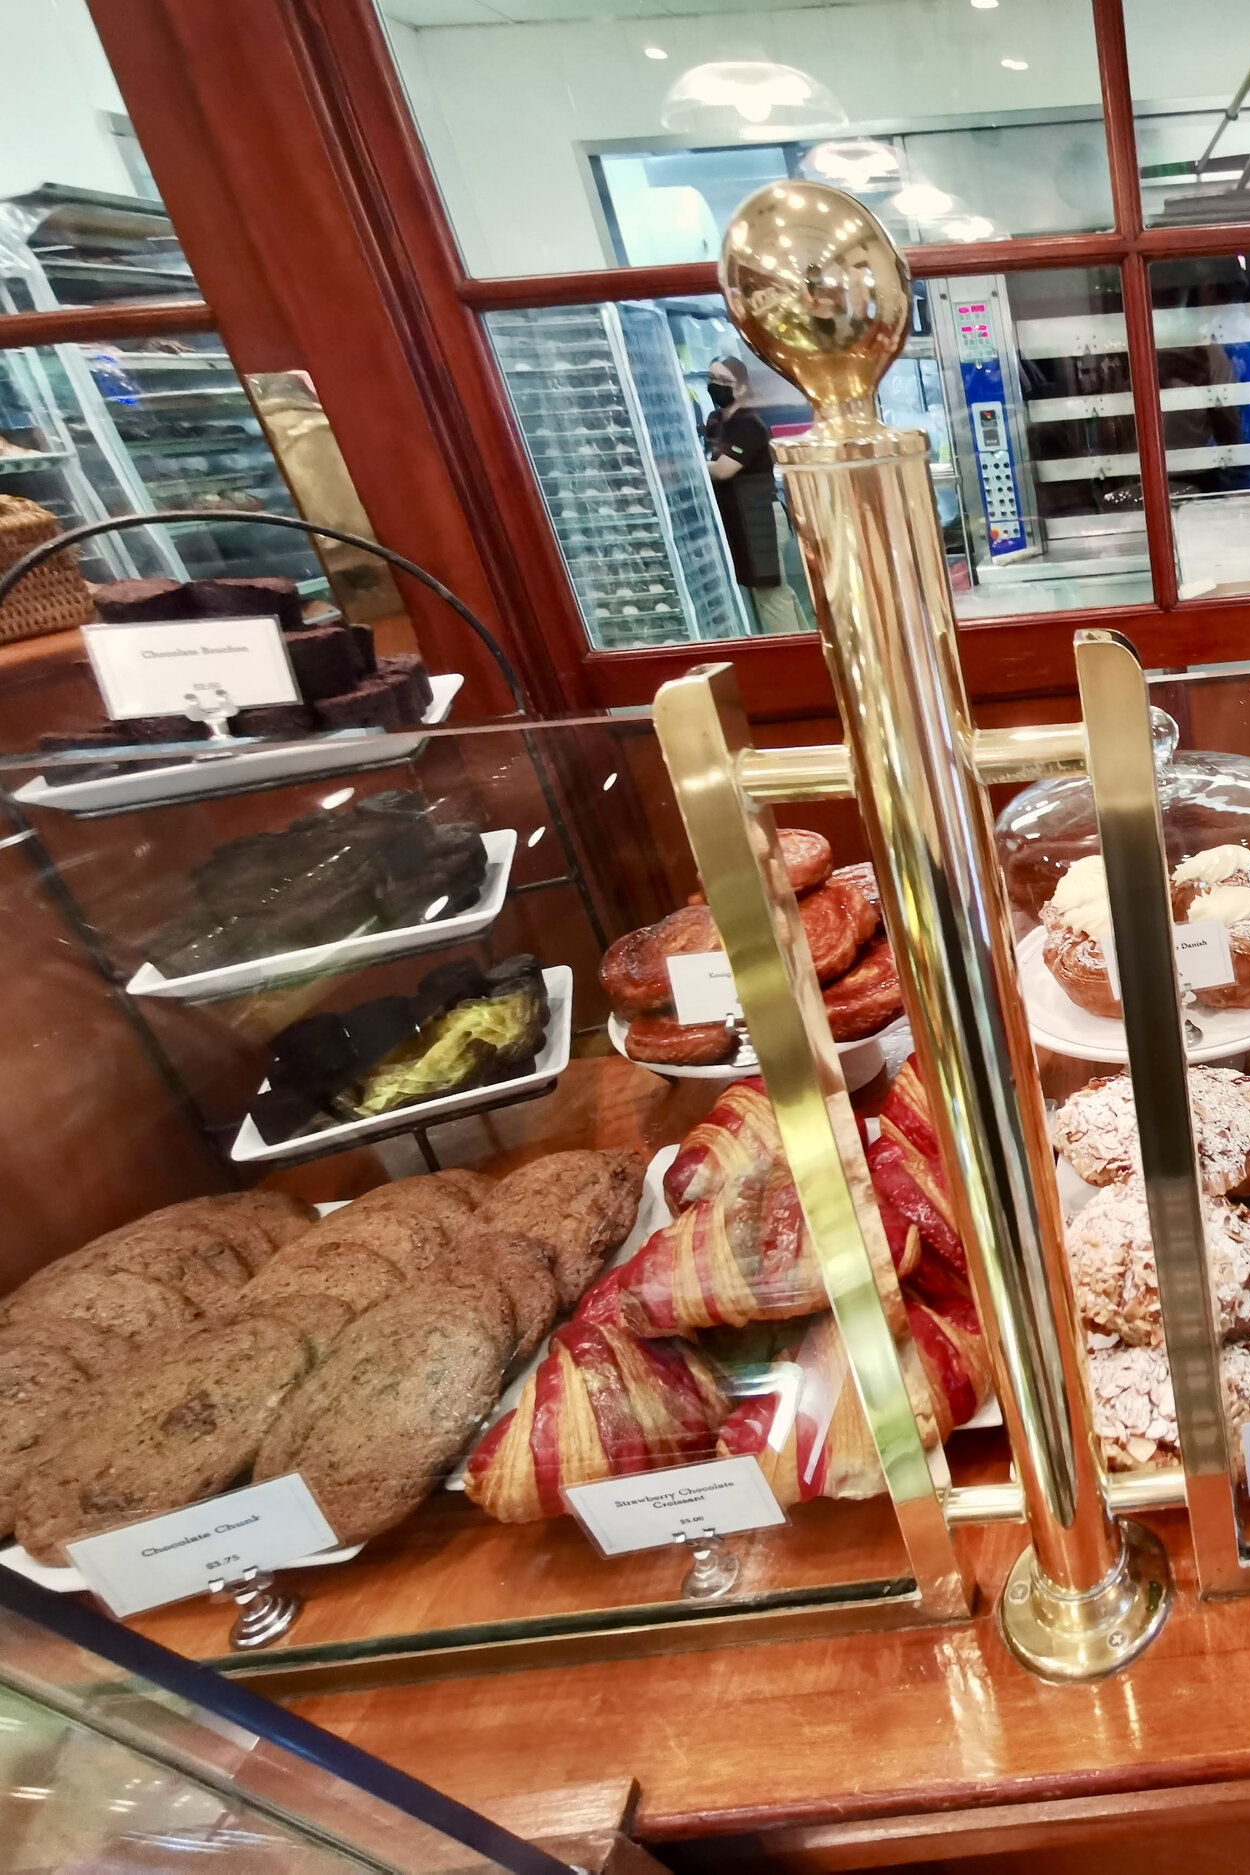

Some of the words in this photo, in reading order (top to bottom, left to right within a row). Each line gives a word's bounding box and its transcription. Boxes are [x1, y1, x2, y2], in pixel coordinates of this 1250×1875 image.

[1181, 940, 1208, 950] Danish
[614, 1493, 675, 1508] Strawberry
[678, 1480, 735, 1496] Chocolate
[652, 1494, 705, 1509] Croissant
[140, 1533, 212, 1557] Chocolate
[214, 1515, 260, 1535] Chunk
